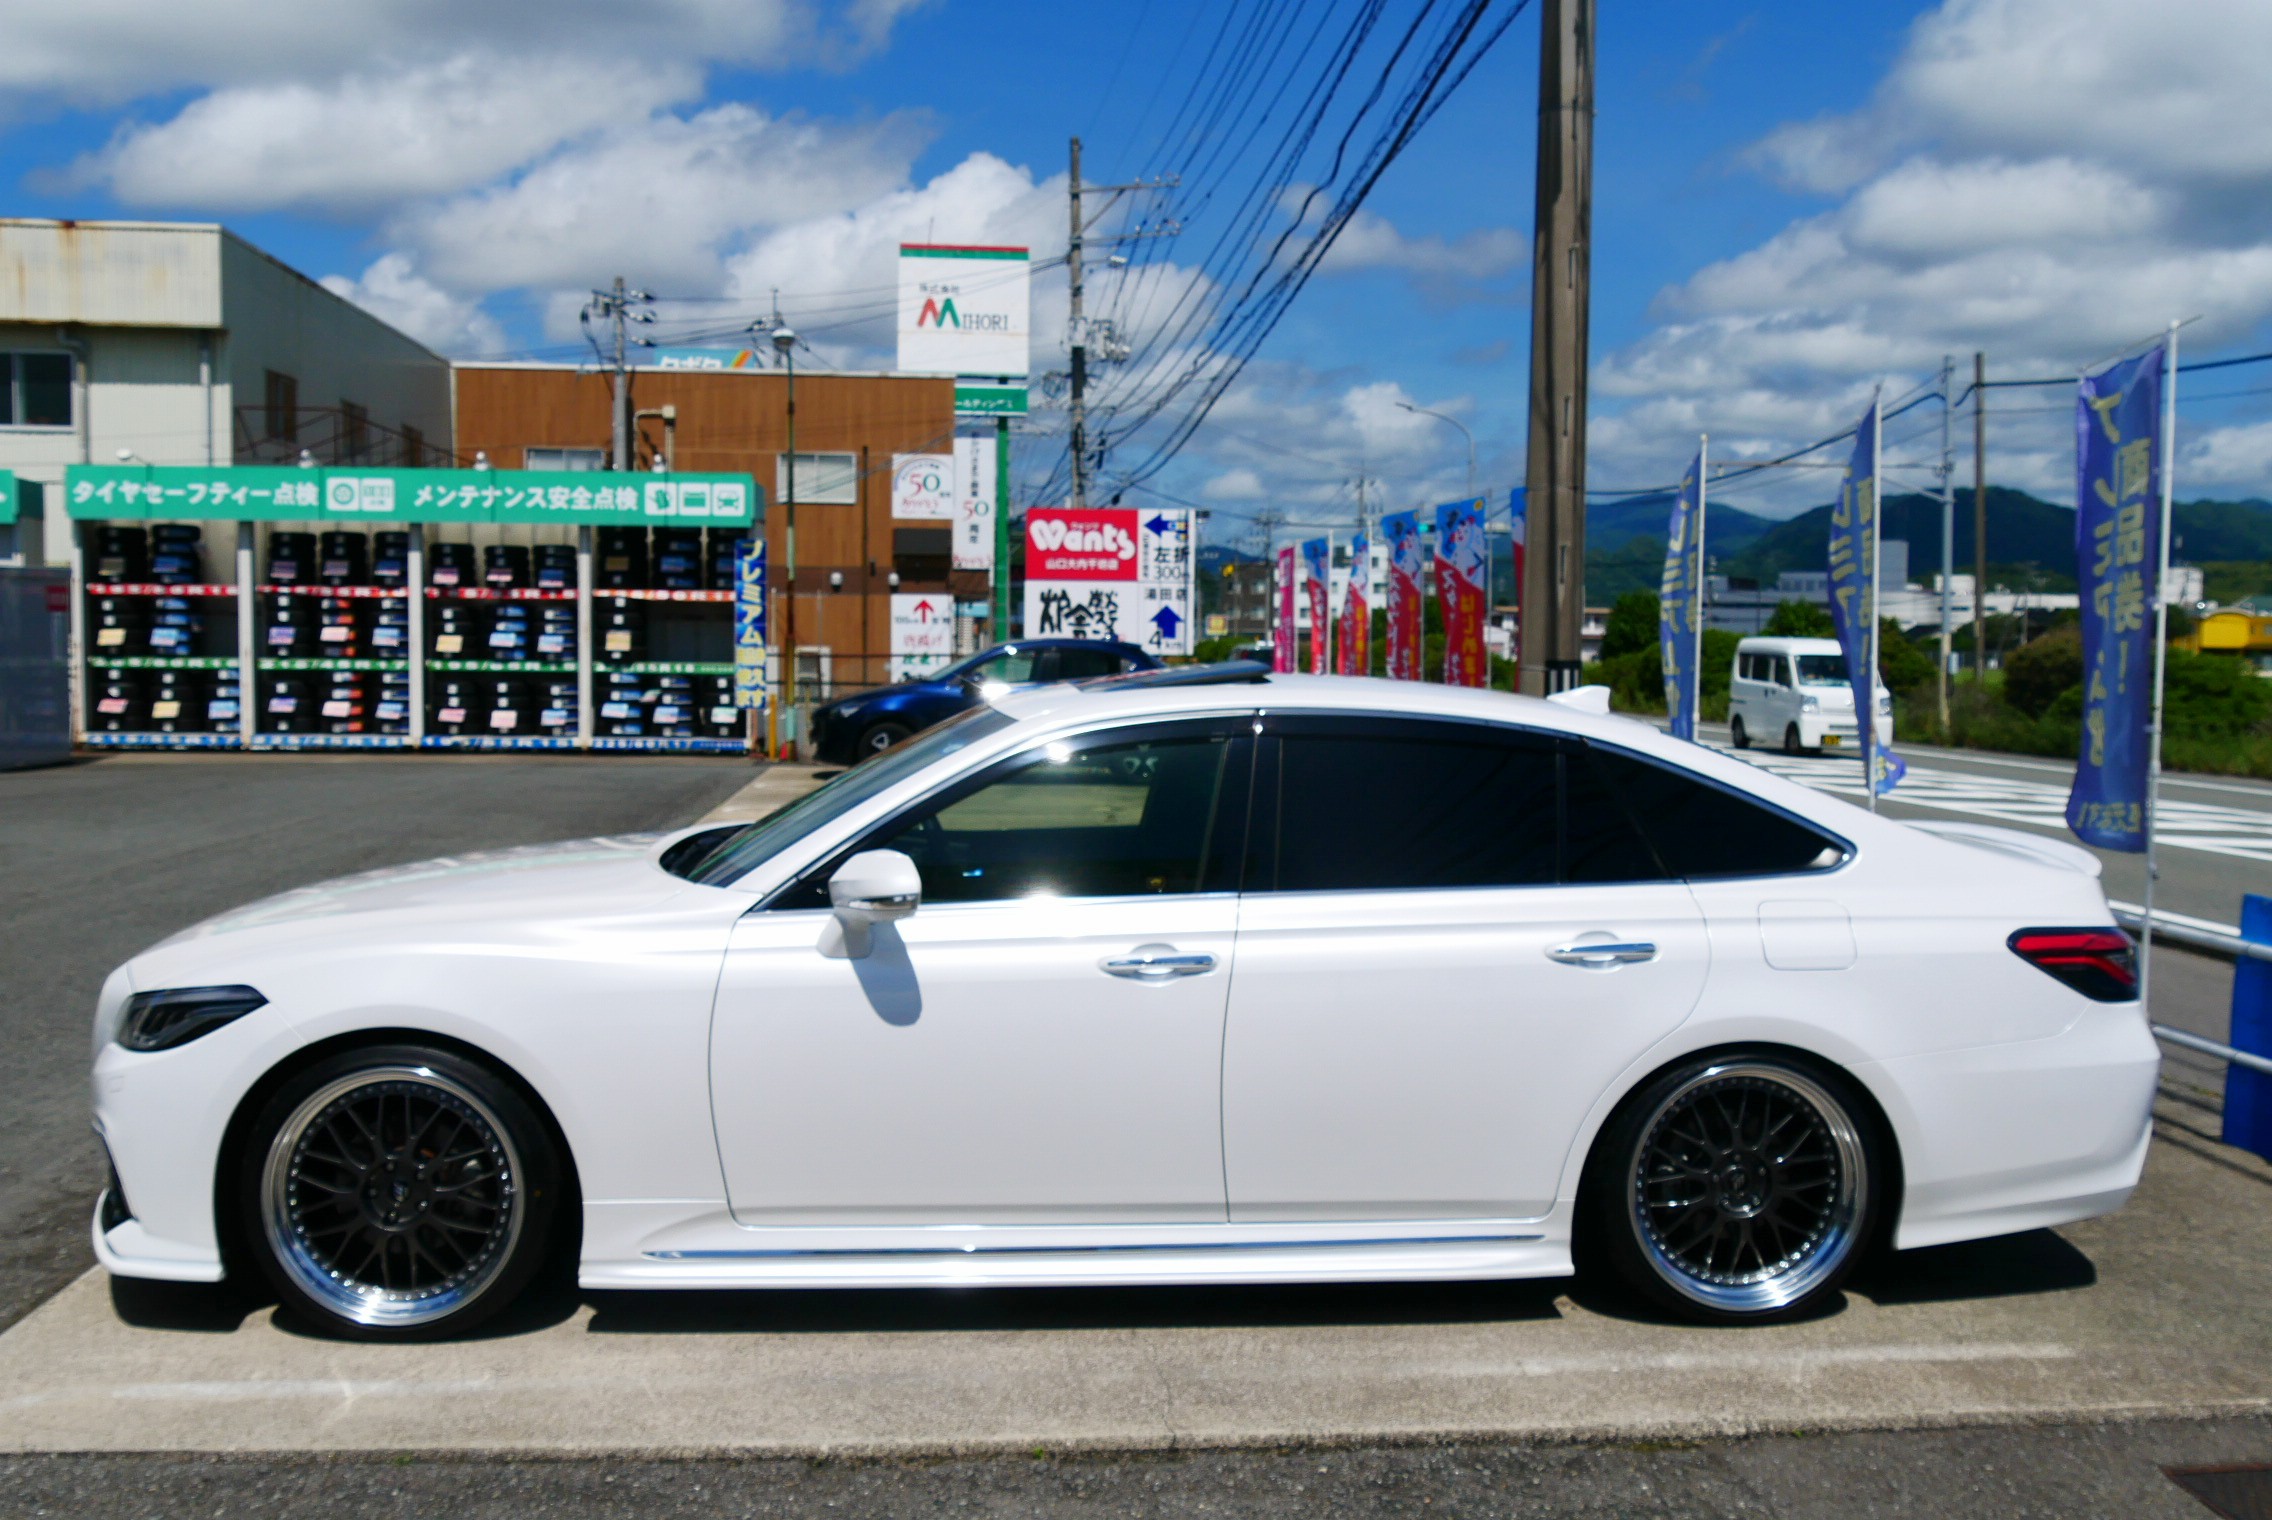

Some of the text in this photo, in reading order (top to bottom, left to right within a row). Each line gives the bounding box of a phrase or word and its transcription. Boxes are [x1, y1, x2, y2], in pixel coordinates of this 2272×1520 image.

[918, 298, 1008, 330] MIHORI
[72, 480, 319, 506] タイヤセーフティー点検
[910, 473, 941, 496] 50
[414, 485, 638, 512] メンテナンス安全点検
[963, 501, 989, 521] 50
[1029, 519, 1136, 560] Wants
[1154, 546, 1189, 564] 左折
